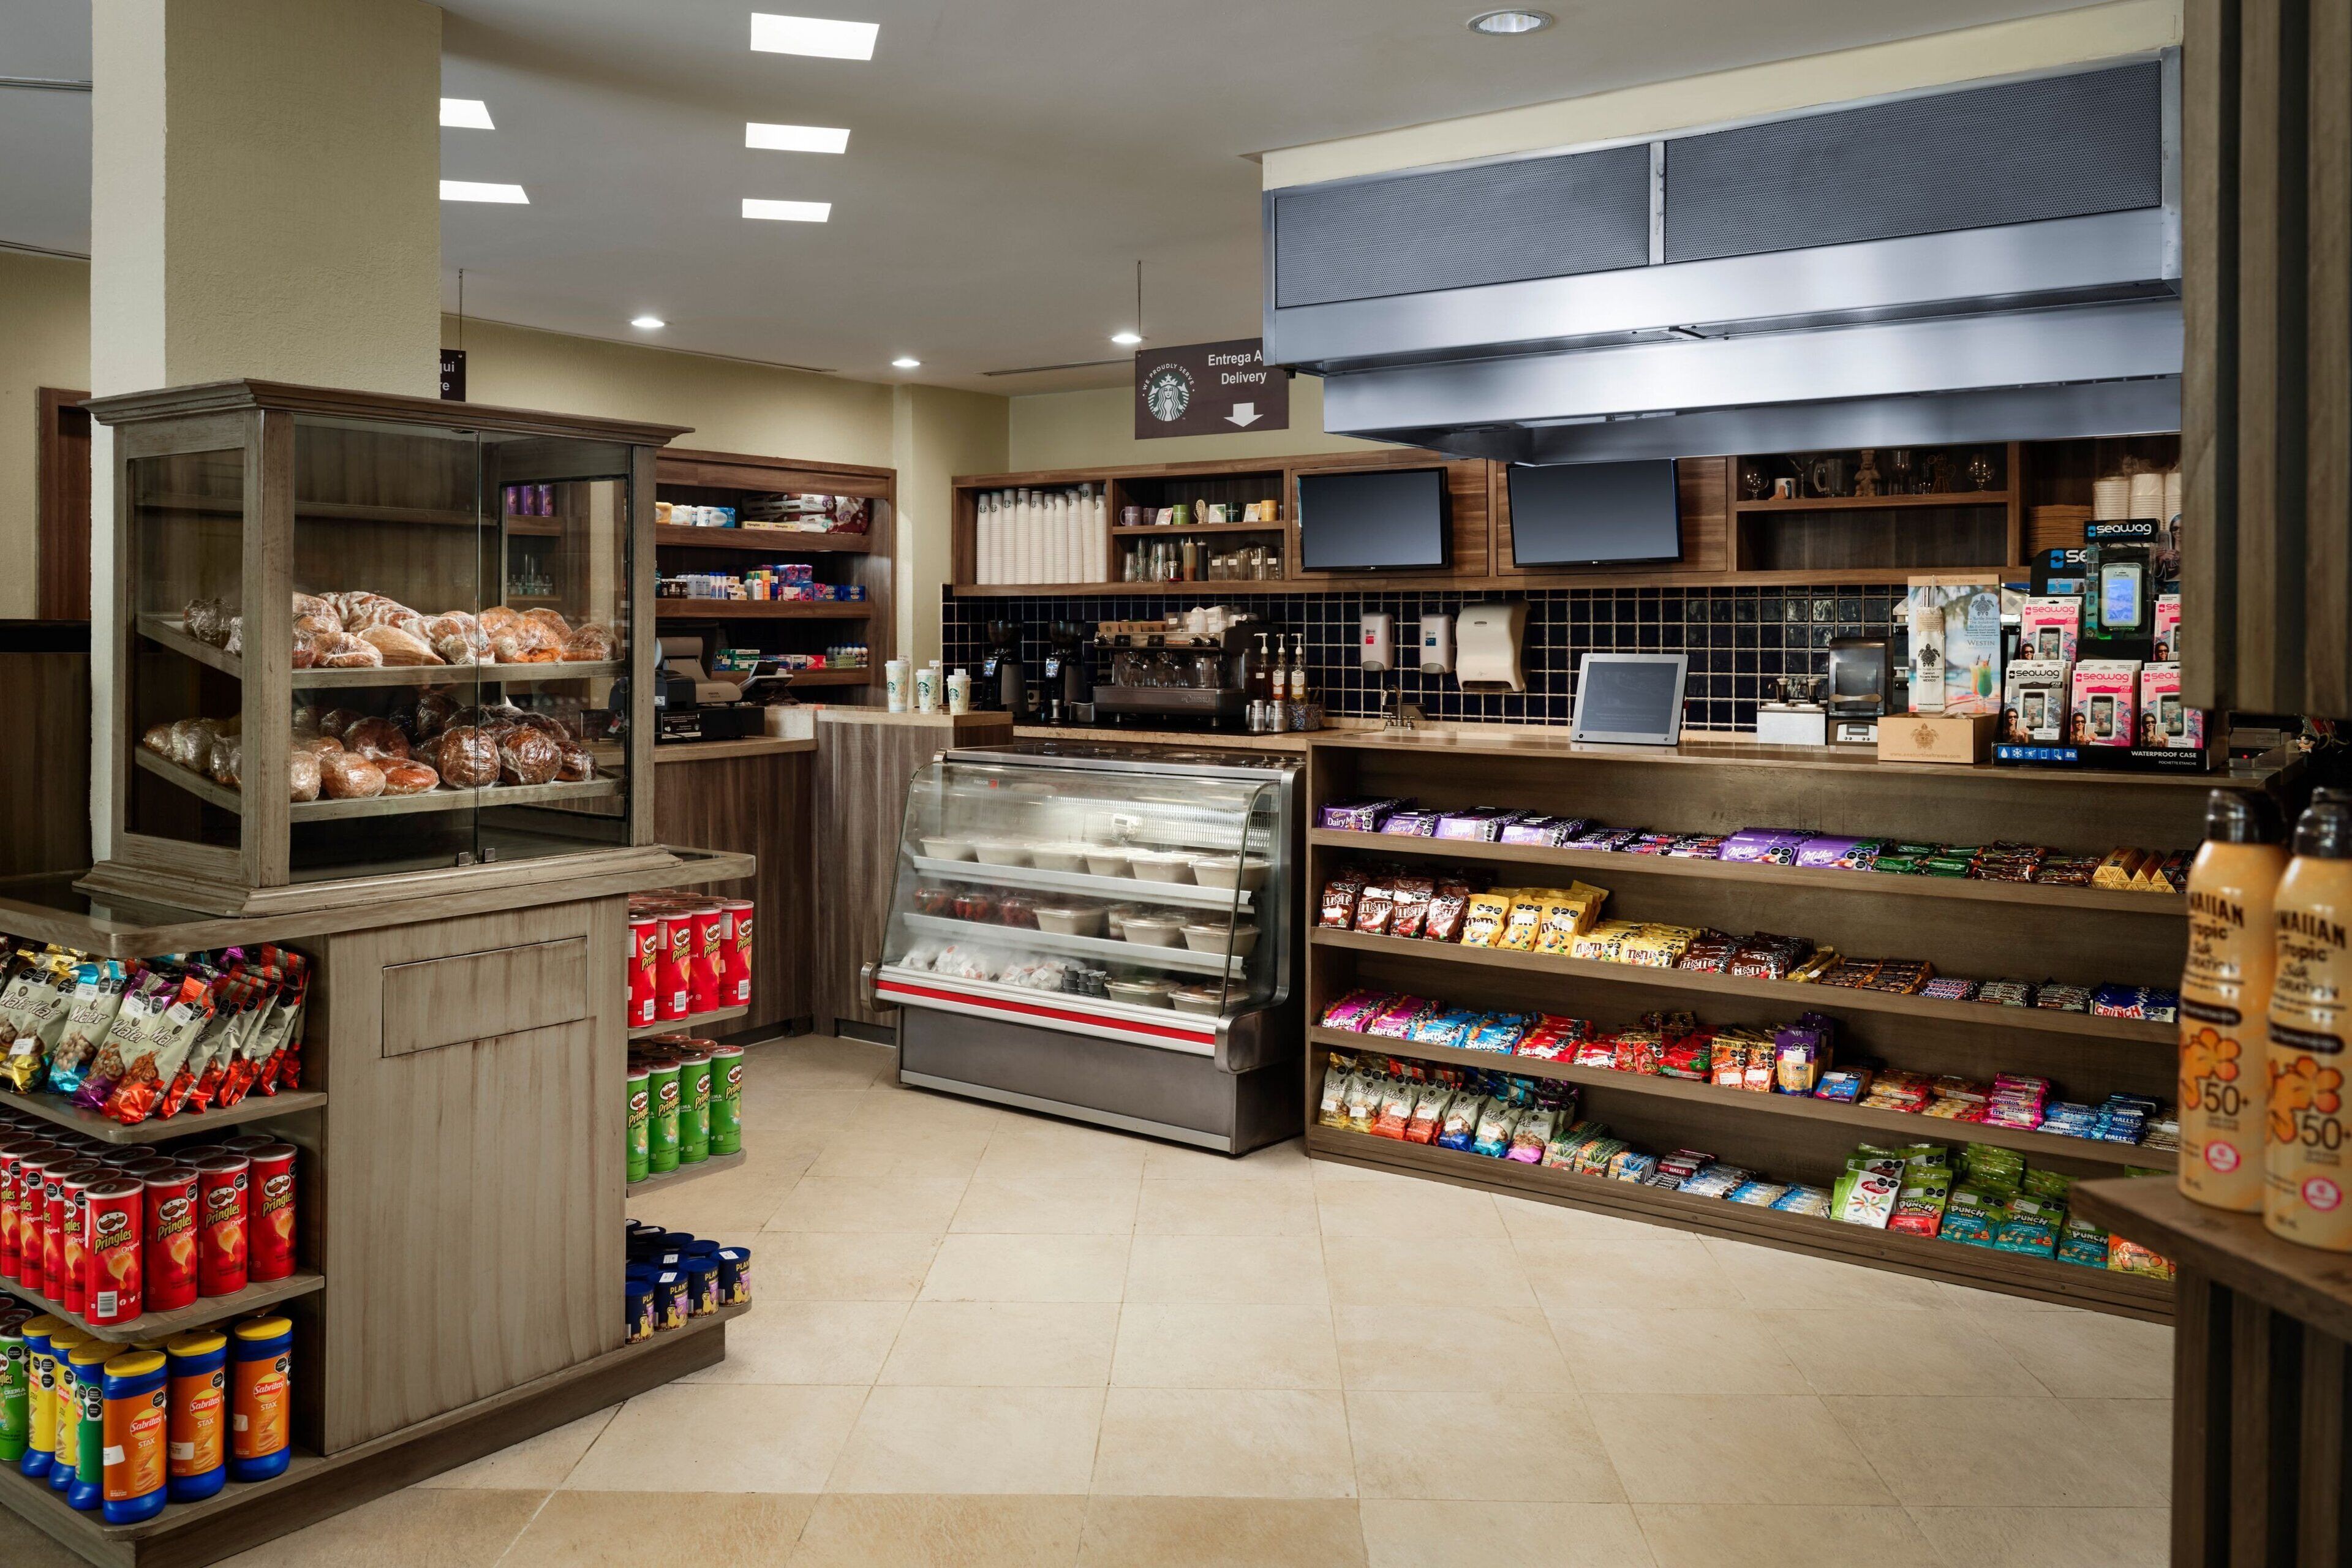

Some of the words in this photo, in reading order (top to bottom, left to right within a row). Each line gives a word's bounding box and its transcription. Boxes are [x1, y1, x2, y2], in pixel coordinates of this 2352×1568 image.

[1208, 353, 1251, 366] Entrega
[1143, 380, 1150, 391] WE
[1150, 363, 1177, 378] PROUDLY
[1179, 366, 1194, 386] SERVE
[1221, 372, 1267, 385] Delivery
[2097, 523, 2152, 535] seawag
[2032, 606, 2076, 615] seawag
[2016, 670, 2060, 679] seawag
[2084, 674, 2129, 683] seawag
[1327, 818, 1346, 827] Dairy
[1387, 824, 1408, 832] Dairy
[1510, 833, 1532, 842] Dairy
[1727, 845, 1759, 856] Milka
[1802, 850, 1834, 861] Milka
[2095, 1005, 2142, 1019] CRUNCH
[1322, 1019, 1356, 1028] Skittles
[109, 1019, 148, 1044] Mafer
[1367, 1027, 1403, 1038] Skittles
[1414, 1030, 1453, 1042] Skittles
[1352, 1082, 1384, 1097] Mafer
[1384, 1088, 1412, 1102] Mafer
[1992, 1098, 2020, 1106] mentos
[2204, 1082, 2250, 1117] 50+
[2105, 1134, 2128, 1142] HALLS
[262, 1189, 294, 1218] Pringles
[1899, 1200, 1936, 1212] PUNCH
[205, 1203, 240, 1230] Pringles
[1950, 1205, 1986, 1218] PUNCH
[2013, 1213, 2049, 1226] PUNCH
[157, 1215, 193, 1243] Pringles
[94, 1229, 132, 1256] Pringles
[2071, 1231, 2109, 1245] PUNCH
[254, 1381, 284, 1395] Sabritas
[190, 1396, 221, 1411] Sabritas
[260, 1401, 277, 1412] STAX
[130, 1416, 162, 1433] Sabritas
[197, 1417, 214, 1428] STAX
[138, 1437, 156, 1449] STAX
